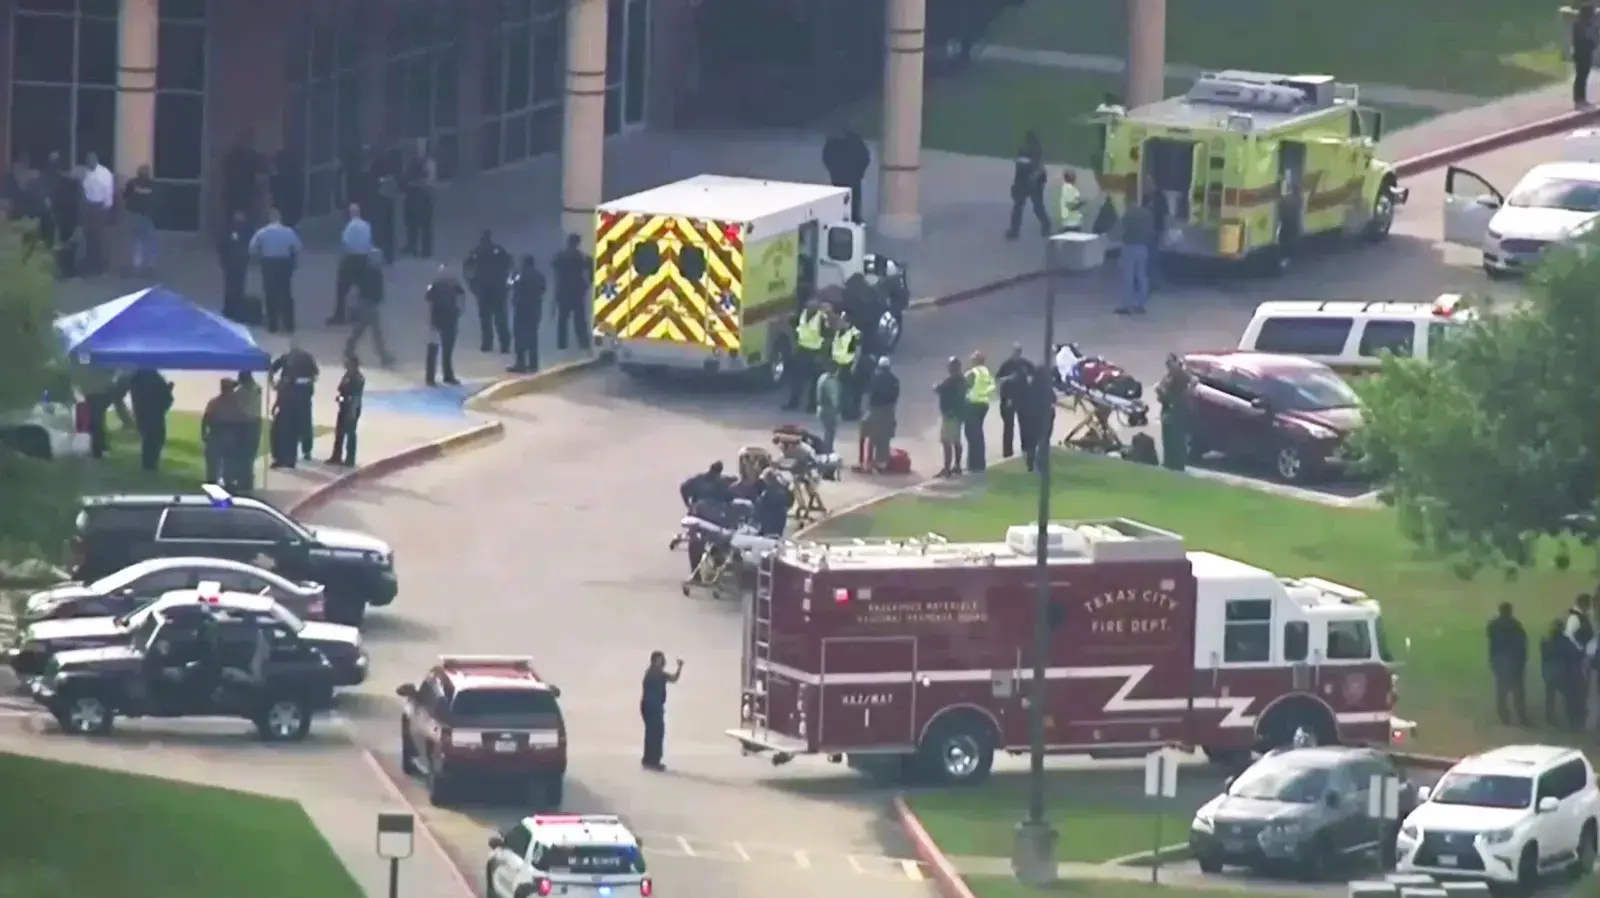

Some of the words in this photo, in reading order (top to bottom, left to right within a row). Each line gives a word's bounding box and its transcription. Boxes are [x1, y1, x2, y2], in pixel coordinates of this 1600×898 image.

[1084, 589, 1136, 613] TEXAS
[1143, 589, 1178, 610] CITY
[1091, 619, 1124, 633] FIRE
